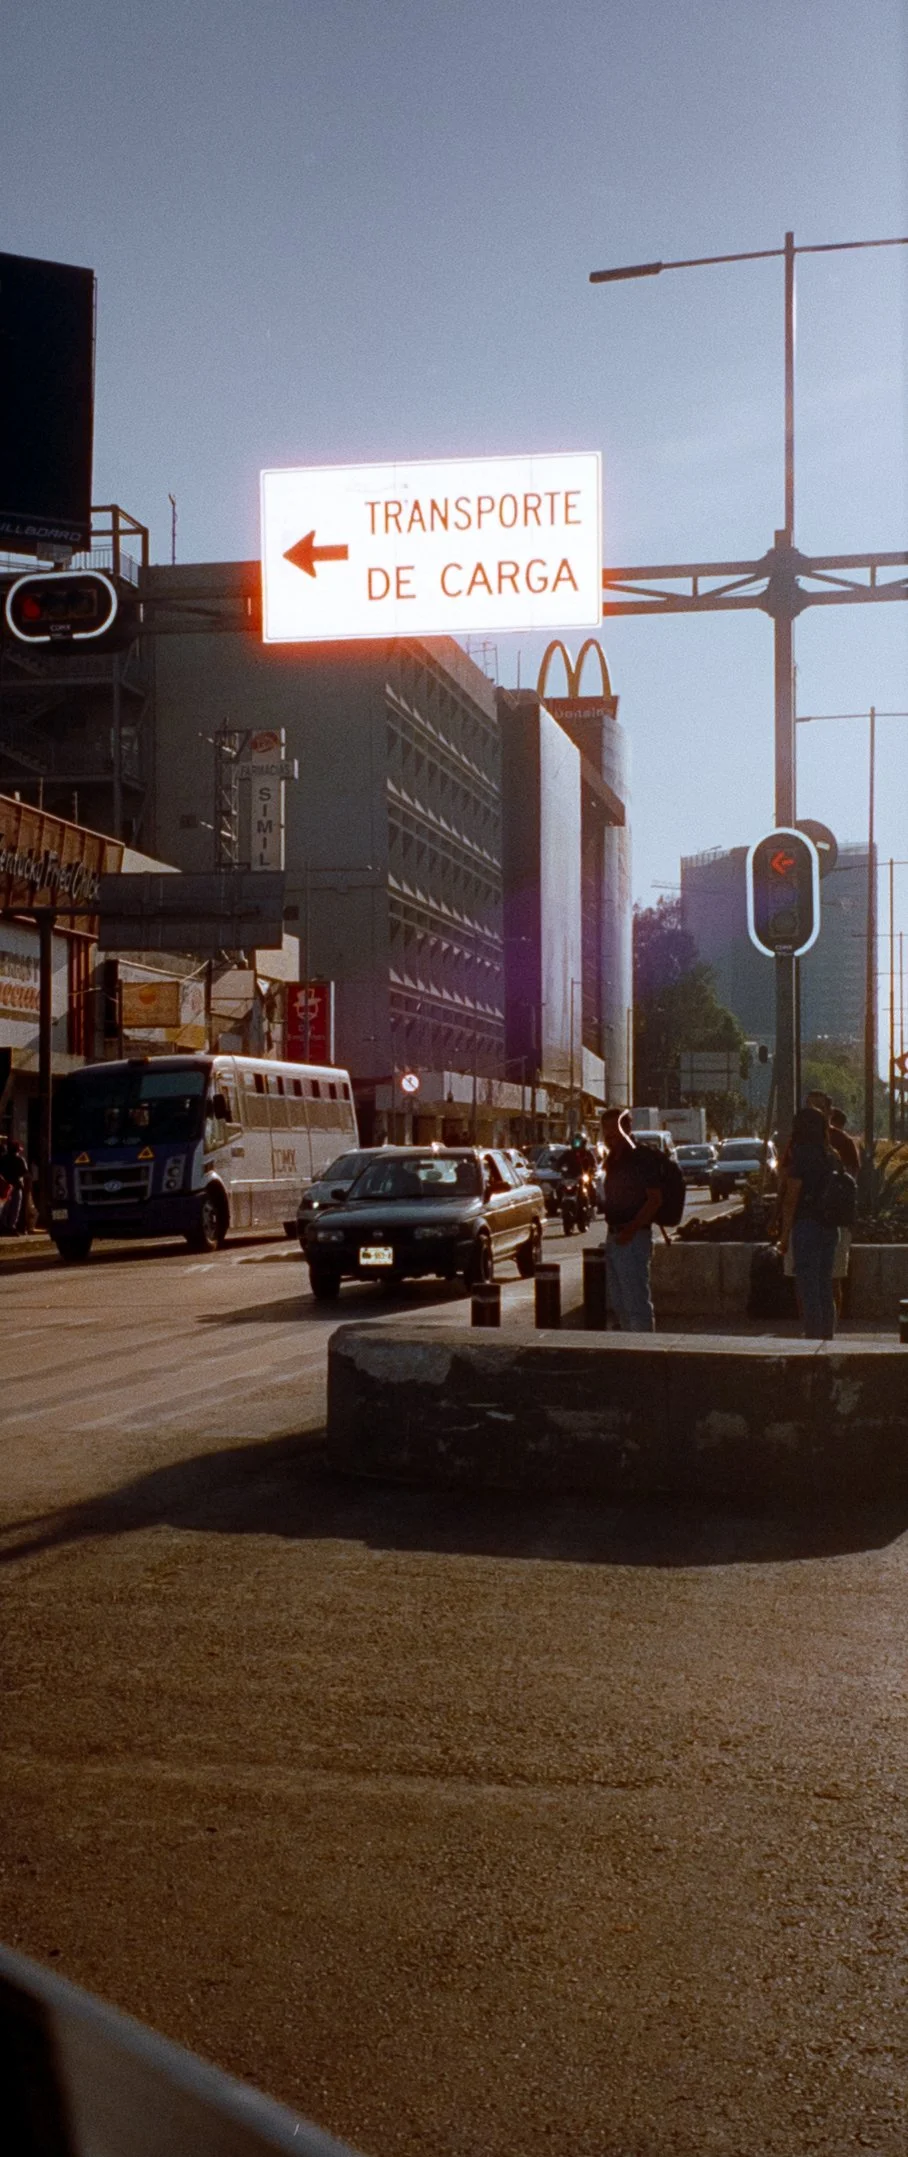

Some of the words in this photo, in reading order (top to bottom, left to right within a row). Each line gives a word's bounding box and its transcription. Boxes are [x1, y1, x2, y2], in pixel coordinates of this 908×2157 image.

[0, 521, 83, 542] ILLBOARD
[364, 491, 582, 535] TRANSPORTE
[367, 565, 416, 601] DE
[440, 558, 579, 598] CARGA
